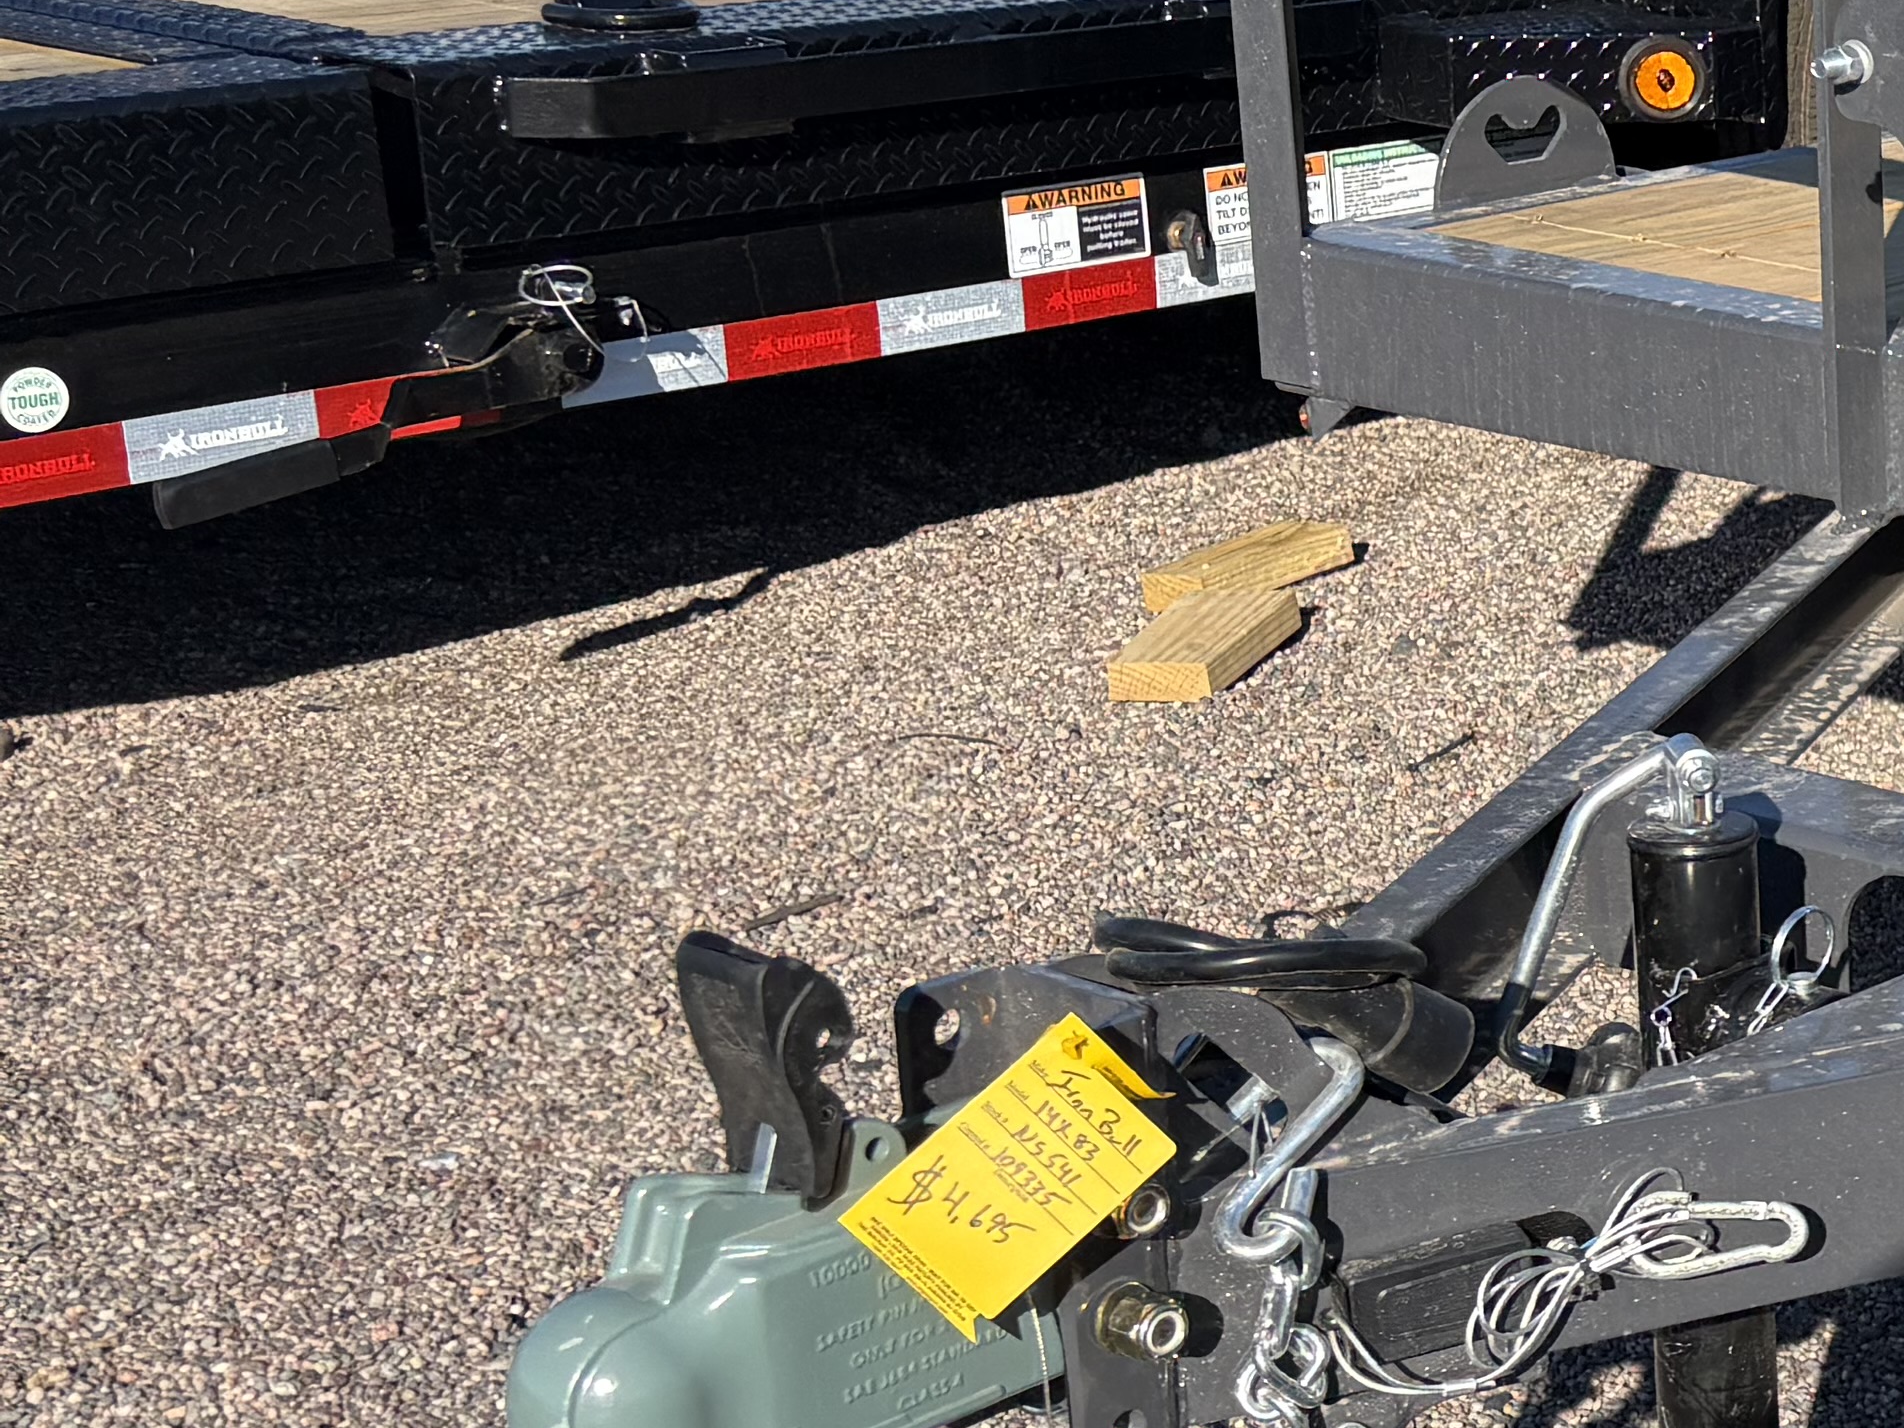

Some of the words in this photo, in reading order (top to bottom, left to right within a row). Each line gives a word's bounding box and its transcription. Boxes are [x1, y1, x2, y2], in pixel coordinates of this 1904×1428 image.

[1039, 182, 1125, 209] WARNING
[1218, 222, 1250, 235] BEYO
[1070, 276, 1139, 303] IRONBULL
[928, 298, 1001, 328] IRONBULL
[777, 328, 854, 352] IRONBULL
[13, 376, 52, 393] POWDER
[8, 392, 59, 410] TOUGH
[190, 415, 288, 449] IRONBULL
[991, 1145, 1074, 1208] 109335
